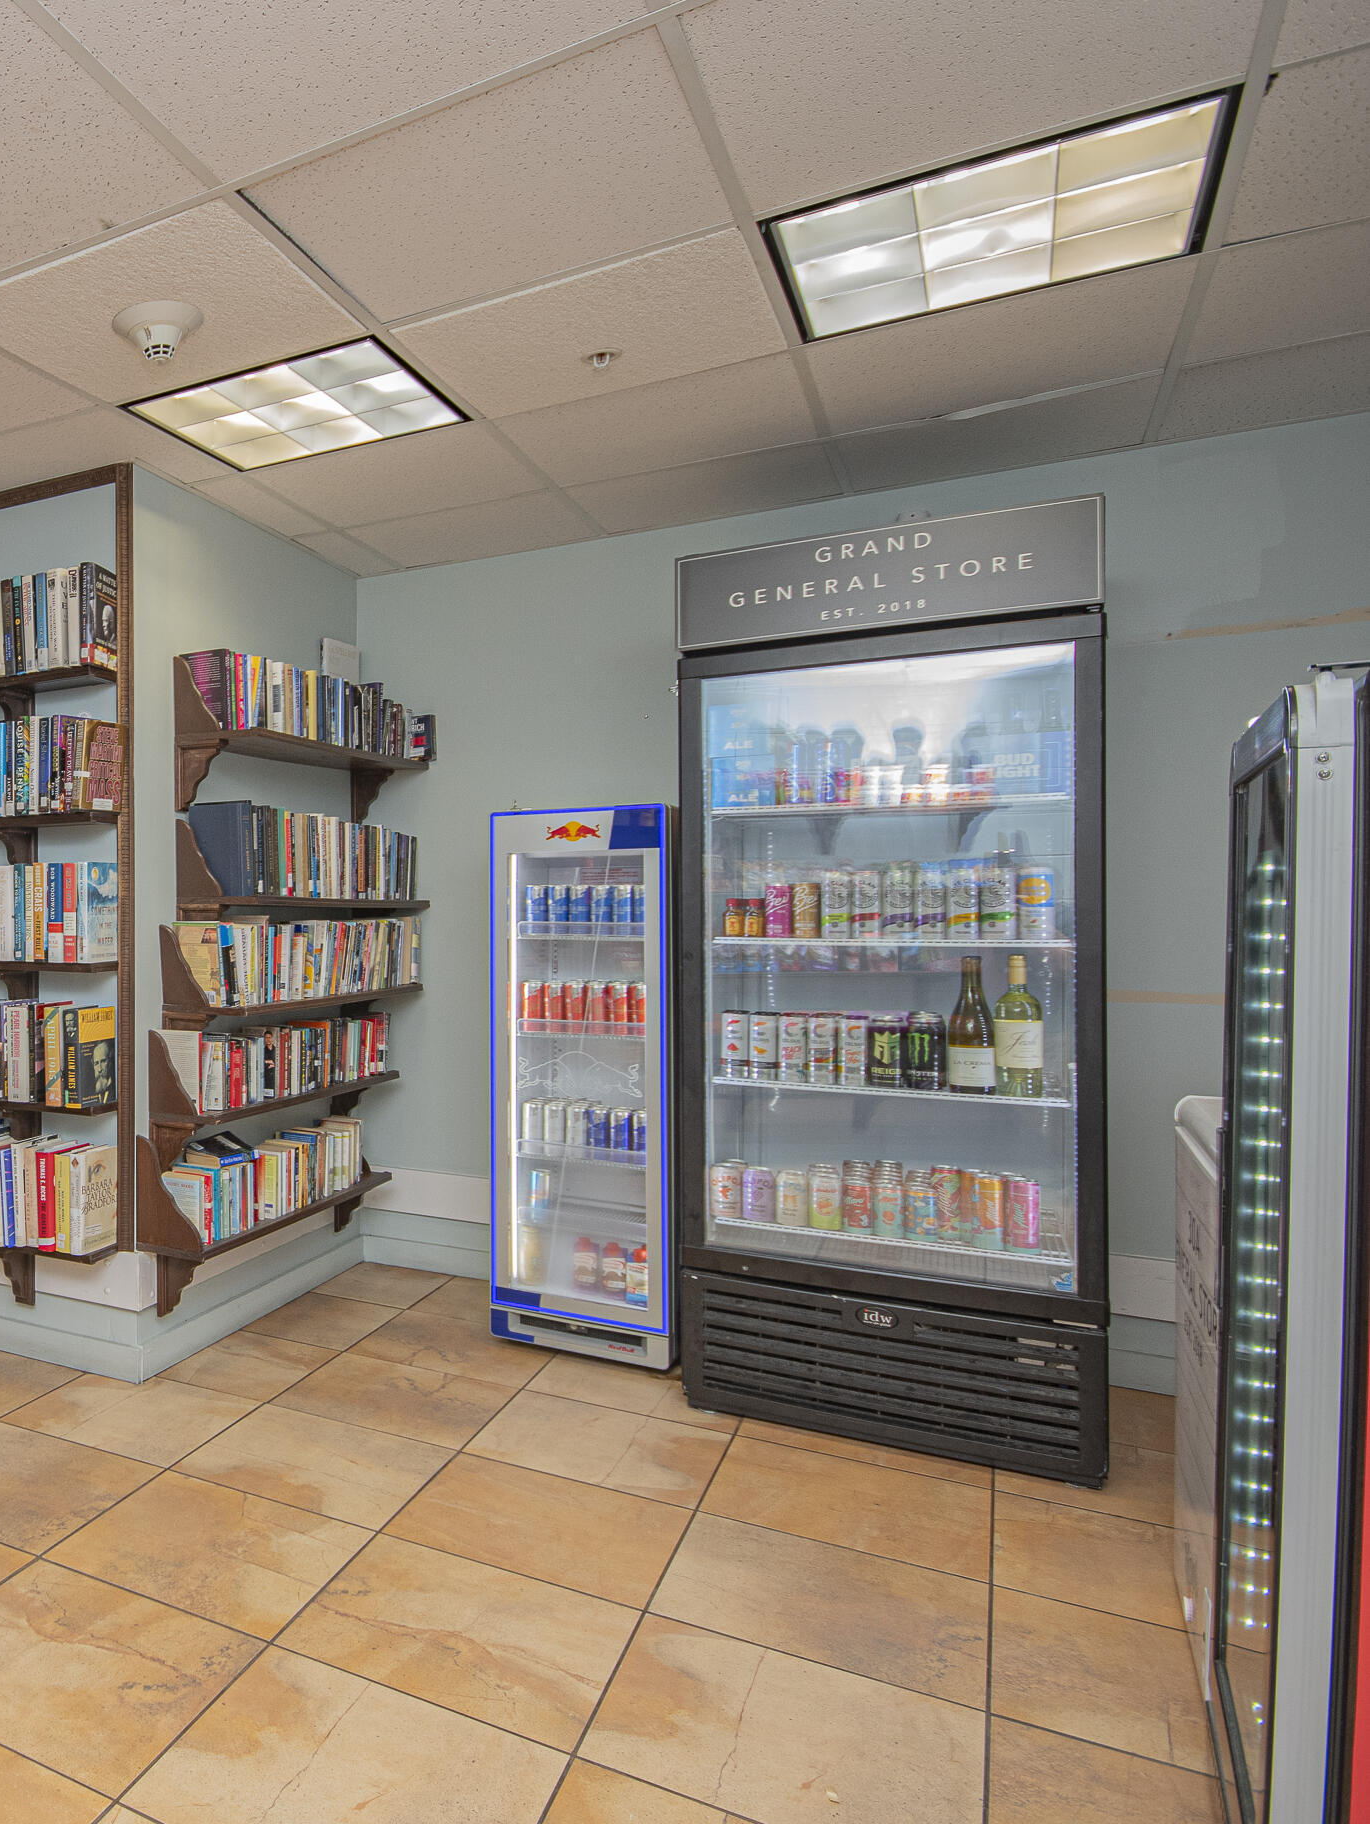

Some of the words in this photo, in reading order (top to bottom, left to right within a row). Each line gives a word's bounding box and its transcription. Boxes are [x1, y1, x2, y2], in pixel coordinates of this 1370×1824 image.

[815, 532, 932, 563] GRAND
[729, 572, 886, 608] GENERAL
[911, 552, 1035, 584] STORE
[821, 606, 865, 621] EST.
[878, 598, 927, 614] 2018
[40, 720, 48, 742] Daniel
[96, 725, 120, 742] STEVE
[723, 739, 754, 750] ALE
[993, 753, 1035, 765] BUD
[88, 760, 121, 780] CRITICAL
[996, 764, 1041, 778] IGHT
[86, 778, 121, 805] MASS
[727, 792, 759, 803] ALE
[34, 886, 43, 912] CRAIS
[80, 1012, 100, 1024] WILLIAM
[100, 1010, 113, 1021] JAMES
[46, 1018, 56, 1049] APRIL
[68, 1046, 76, 1070] WILLIAM
[68, 1071, 76, 1089] JAMES
[81, 1178, 113, 1195] BARBARA
[86, 1187, 112, 1202] TAYLOR
[863, 1309, 893, 1324] idw
